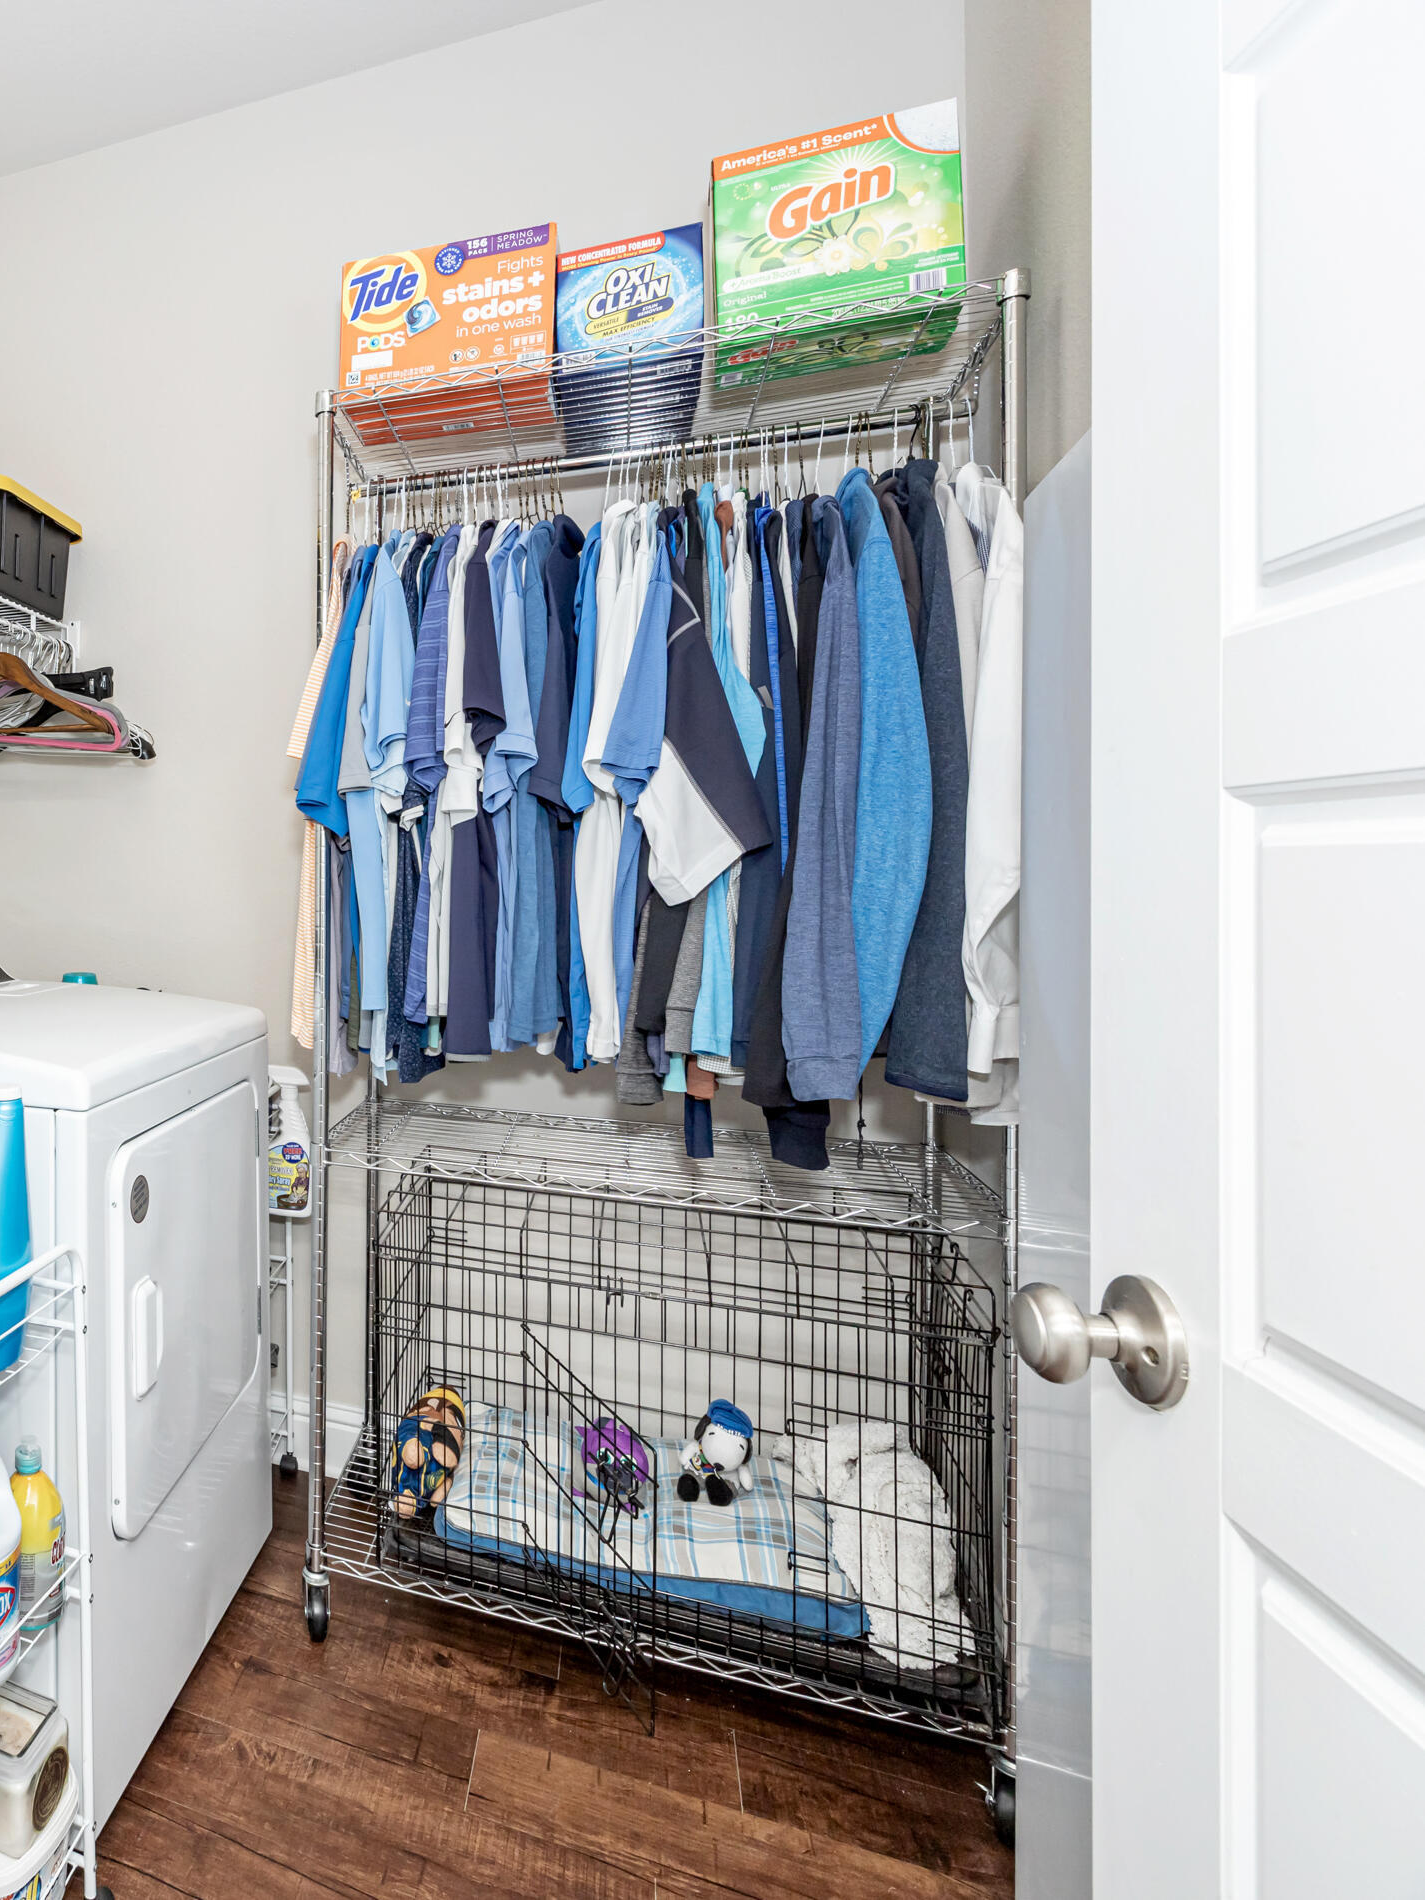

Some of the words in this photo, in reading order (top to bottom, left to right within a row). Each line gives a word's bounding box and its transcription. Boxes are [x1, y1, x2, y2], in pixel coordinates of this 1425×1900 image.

[720, 139, 798, 172] America's
[800, 136, 818, 150] #1
[768, 163, 893, 240] Gain
[466, 237, 488, 250] 156
[496, 229, 534, 243] SPRING
[468, 247, 488, 257] PACS
[561, 255, 577, 267] NEW
[577, 244, 627, 263] CONCENTRATED
[628, 236, 662, 252] FORMULA
[496, 255, 544, 274] Fights
[442, 275, 525, 305] stains
[527, 270, 545, 287] +
[605, 262, 655, 295] OXI
[348, 263, 420, 324] Tide
[587, 275, 670, 320] CLEAN
[723, 291, 767, 308] Original
[462, 293, 543, 323] odors
[637, 305, 663, 318] REMOVER
[641, 302, 658, 312] STAIN
[456, 325, 469, 338] in
[471, 319, 500, 336] one
[503, 313, 542, 331] wash
[593, 317, 620, 329] VERSATILE
[602, 328, 618, 337] MAX
[620, 316, 655, 332] EFFICIENCY
[357, 330, 406, 353] PODS
